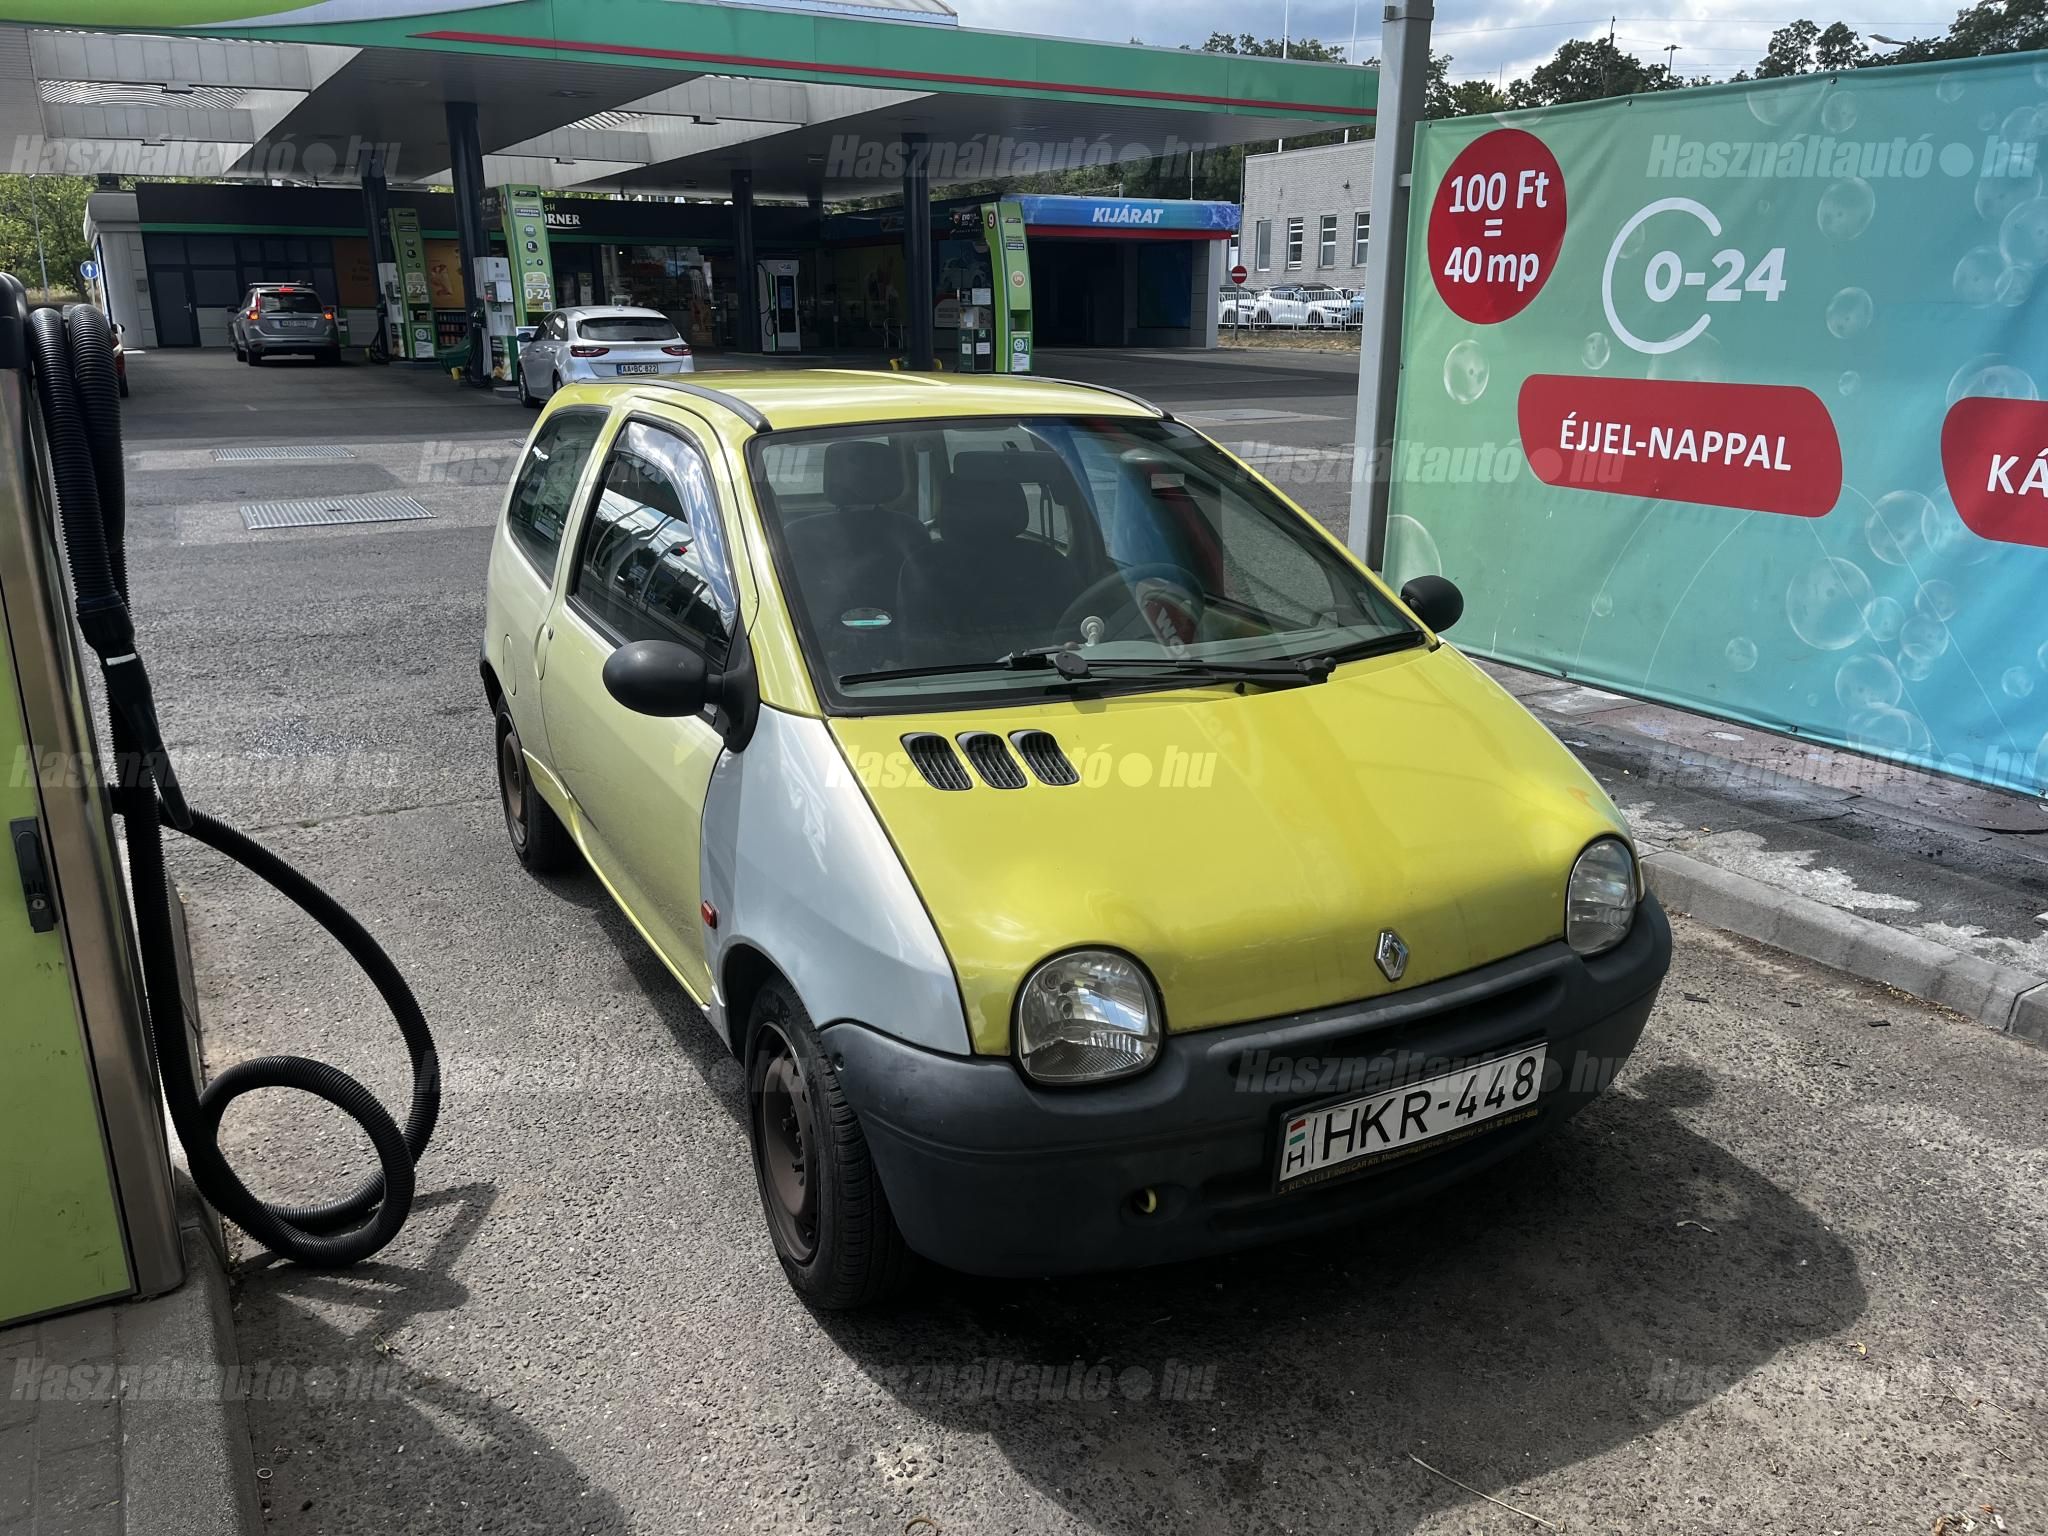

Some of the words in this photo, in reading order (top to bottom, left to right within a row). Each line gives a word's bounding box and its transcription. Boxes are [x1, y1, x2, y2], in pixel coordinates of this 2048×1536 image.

[1449, 172, 1507, 212] 100
[1516, 169, 1550, 209] Ft
[988, 213, 994, 227] 9
[1092, 204, 1164, 224] KIJÁRAT
[1444, 246, 1483, 284] 40
[1486, 253, 1540, 292] mp
[1644, 247, 1787, 303] 0-24
[407, 285, 427, 294] 0-24
[525, 288, 551, 300] 0-24
[1560, 411, 1792, 472] ÉJJEL-NAPPAL
[1322, 1057, 1538, 1161] HKR-448
[1286, 1145, 1305, 1173] H
